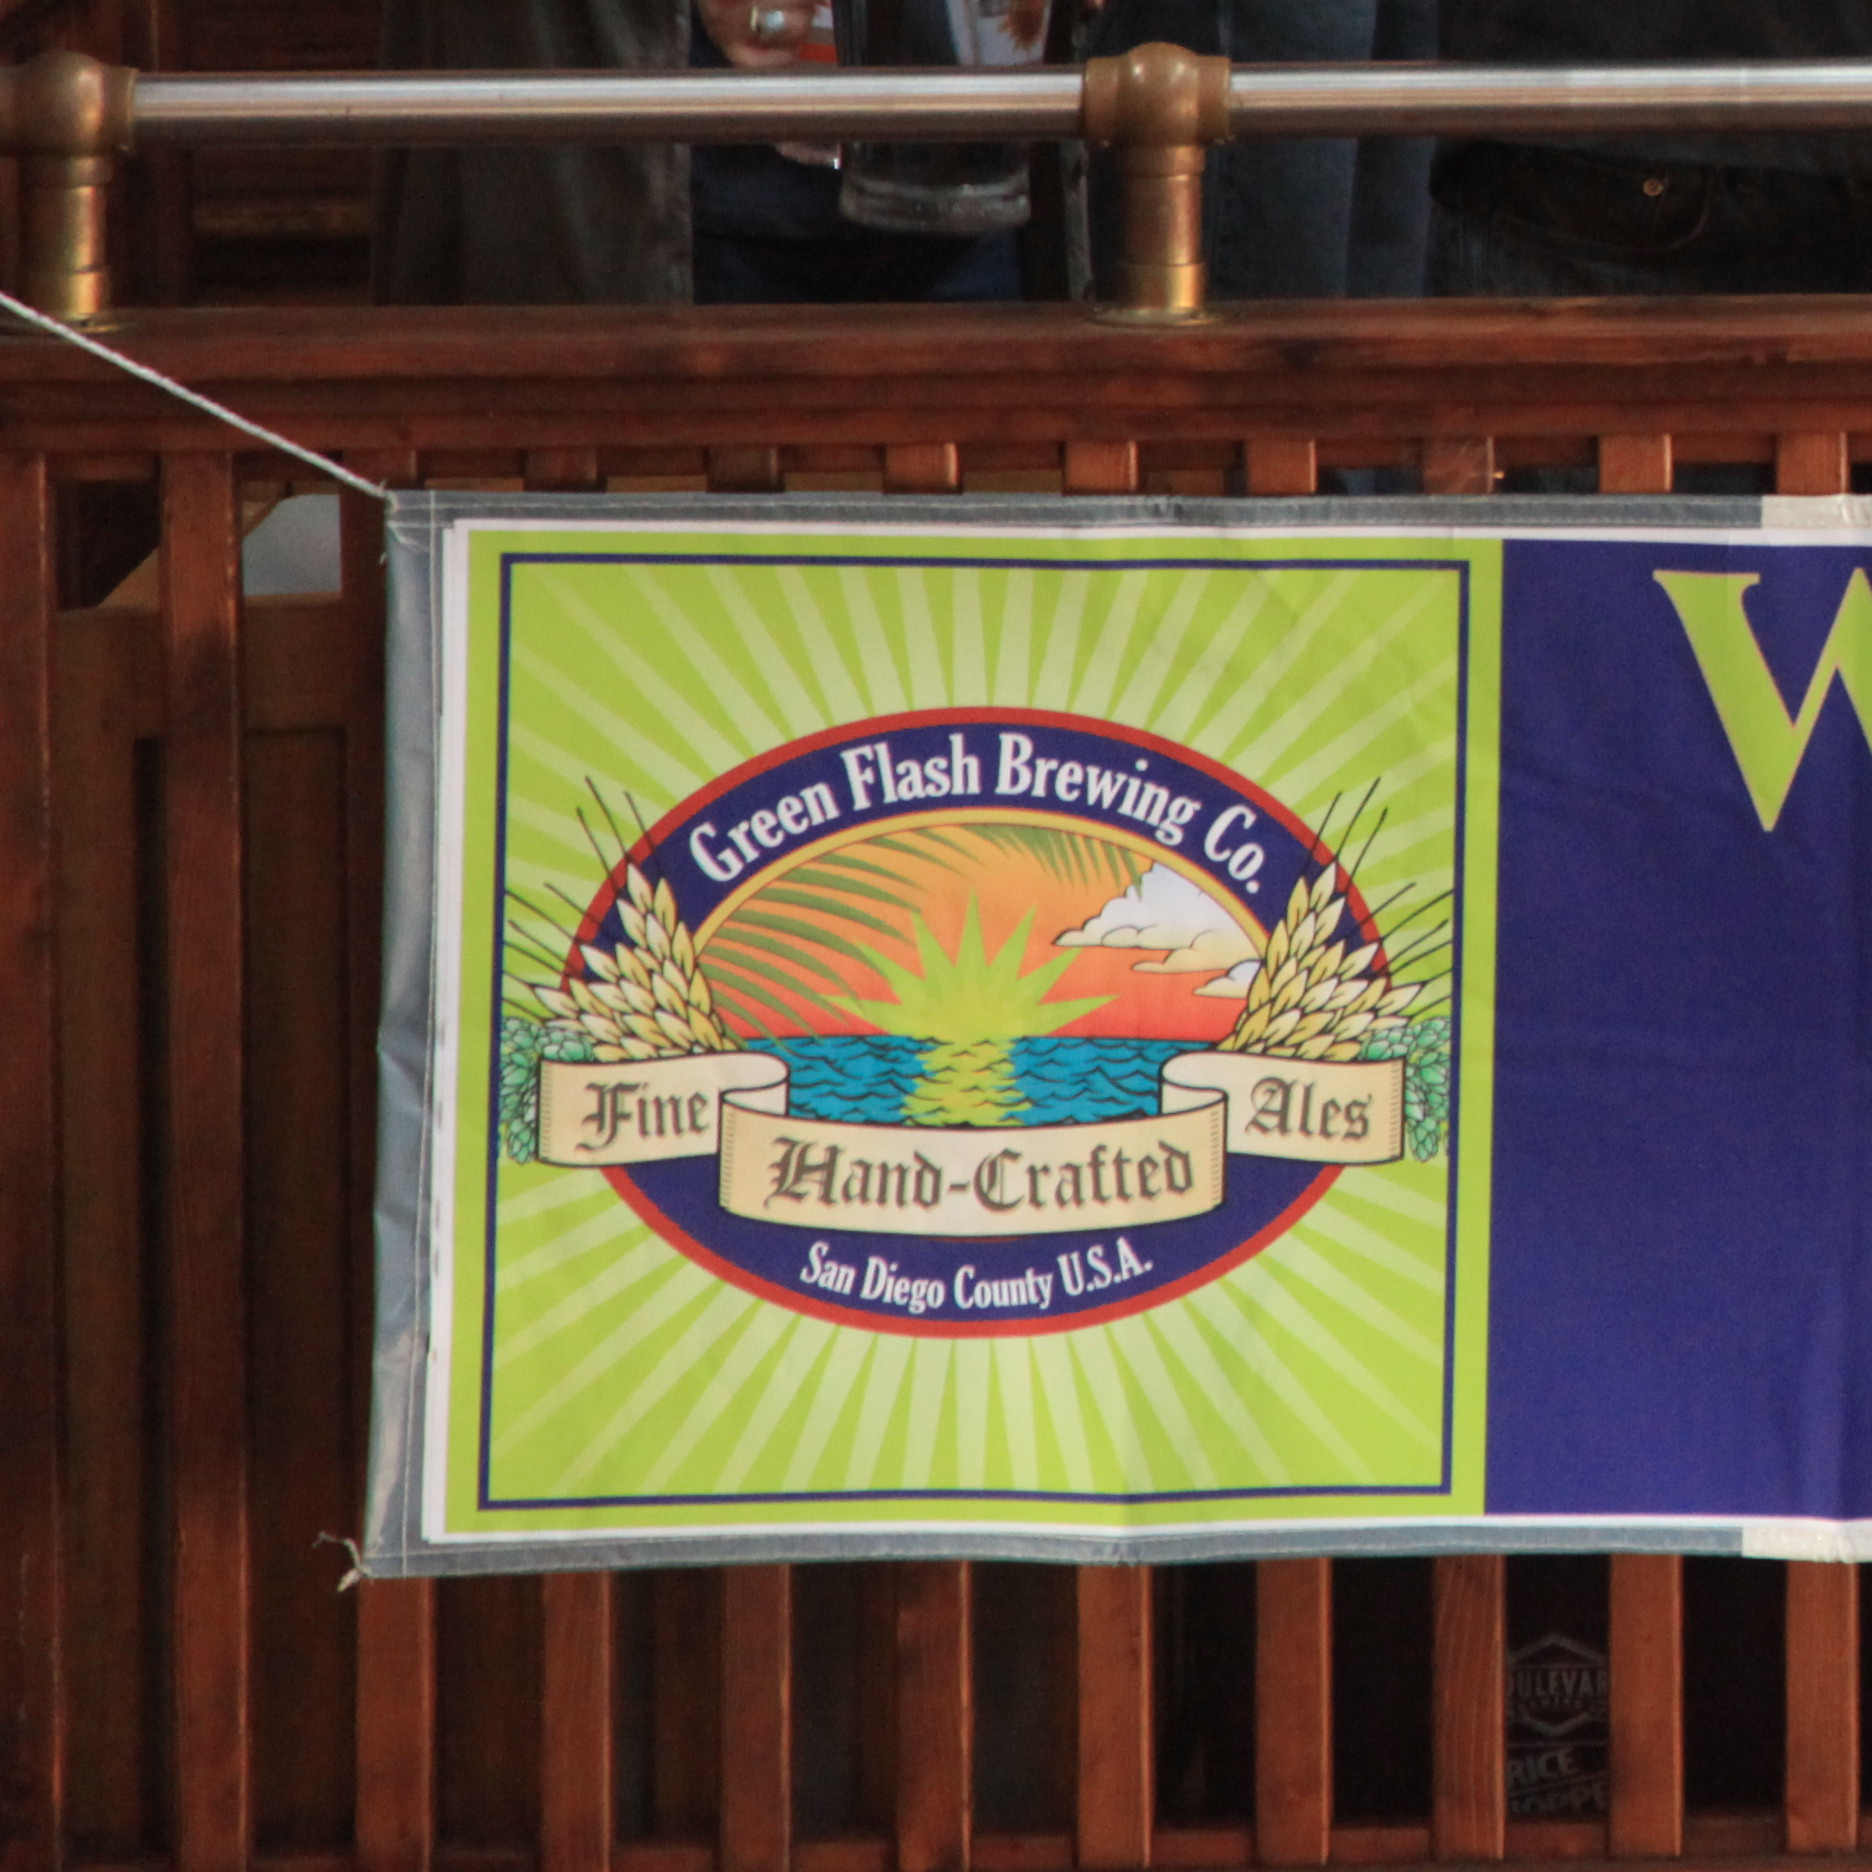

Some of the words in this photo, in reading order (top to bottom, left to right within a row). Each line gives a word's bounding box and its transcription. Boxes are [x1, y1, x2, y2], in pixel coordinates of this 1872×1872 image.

[688, 787, 840, 888] Green
[838, 733, 984, 814] Flash
[994, 731, 1202, 846] Brewing
[1202, 801, 1264, 895] Co.
[580, 1079, 711, 1151] Fine
[1243, 1075, 1378, 1143] Ales
[762, 1135, 1197, 1213] Hand-Crafted
[799, 1239, 856, 1292] San
[859, 1254, 947, 1314] Diego
[952, 1261, 1055, 1314] County
[1056, 1236, 1155, 1292] U.S.A.
